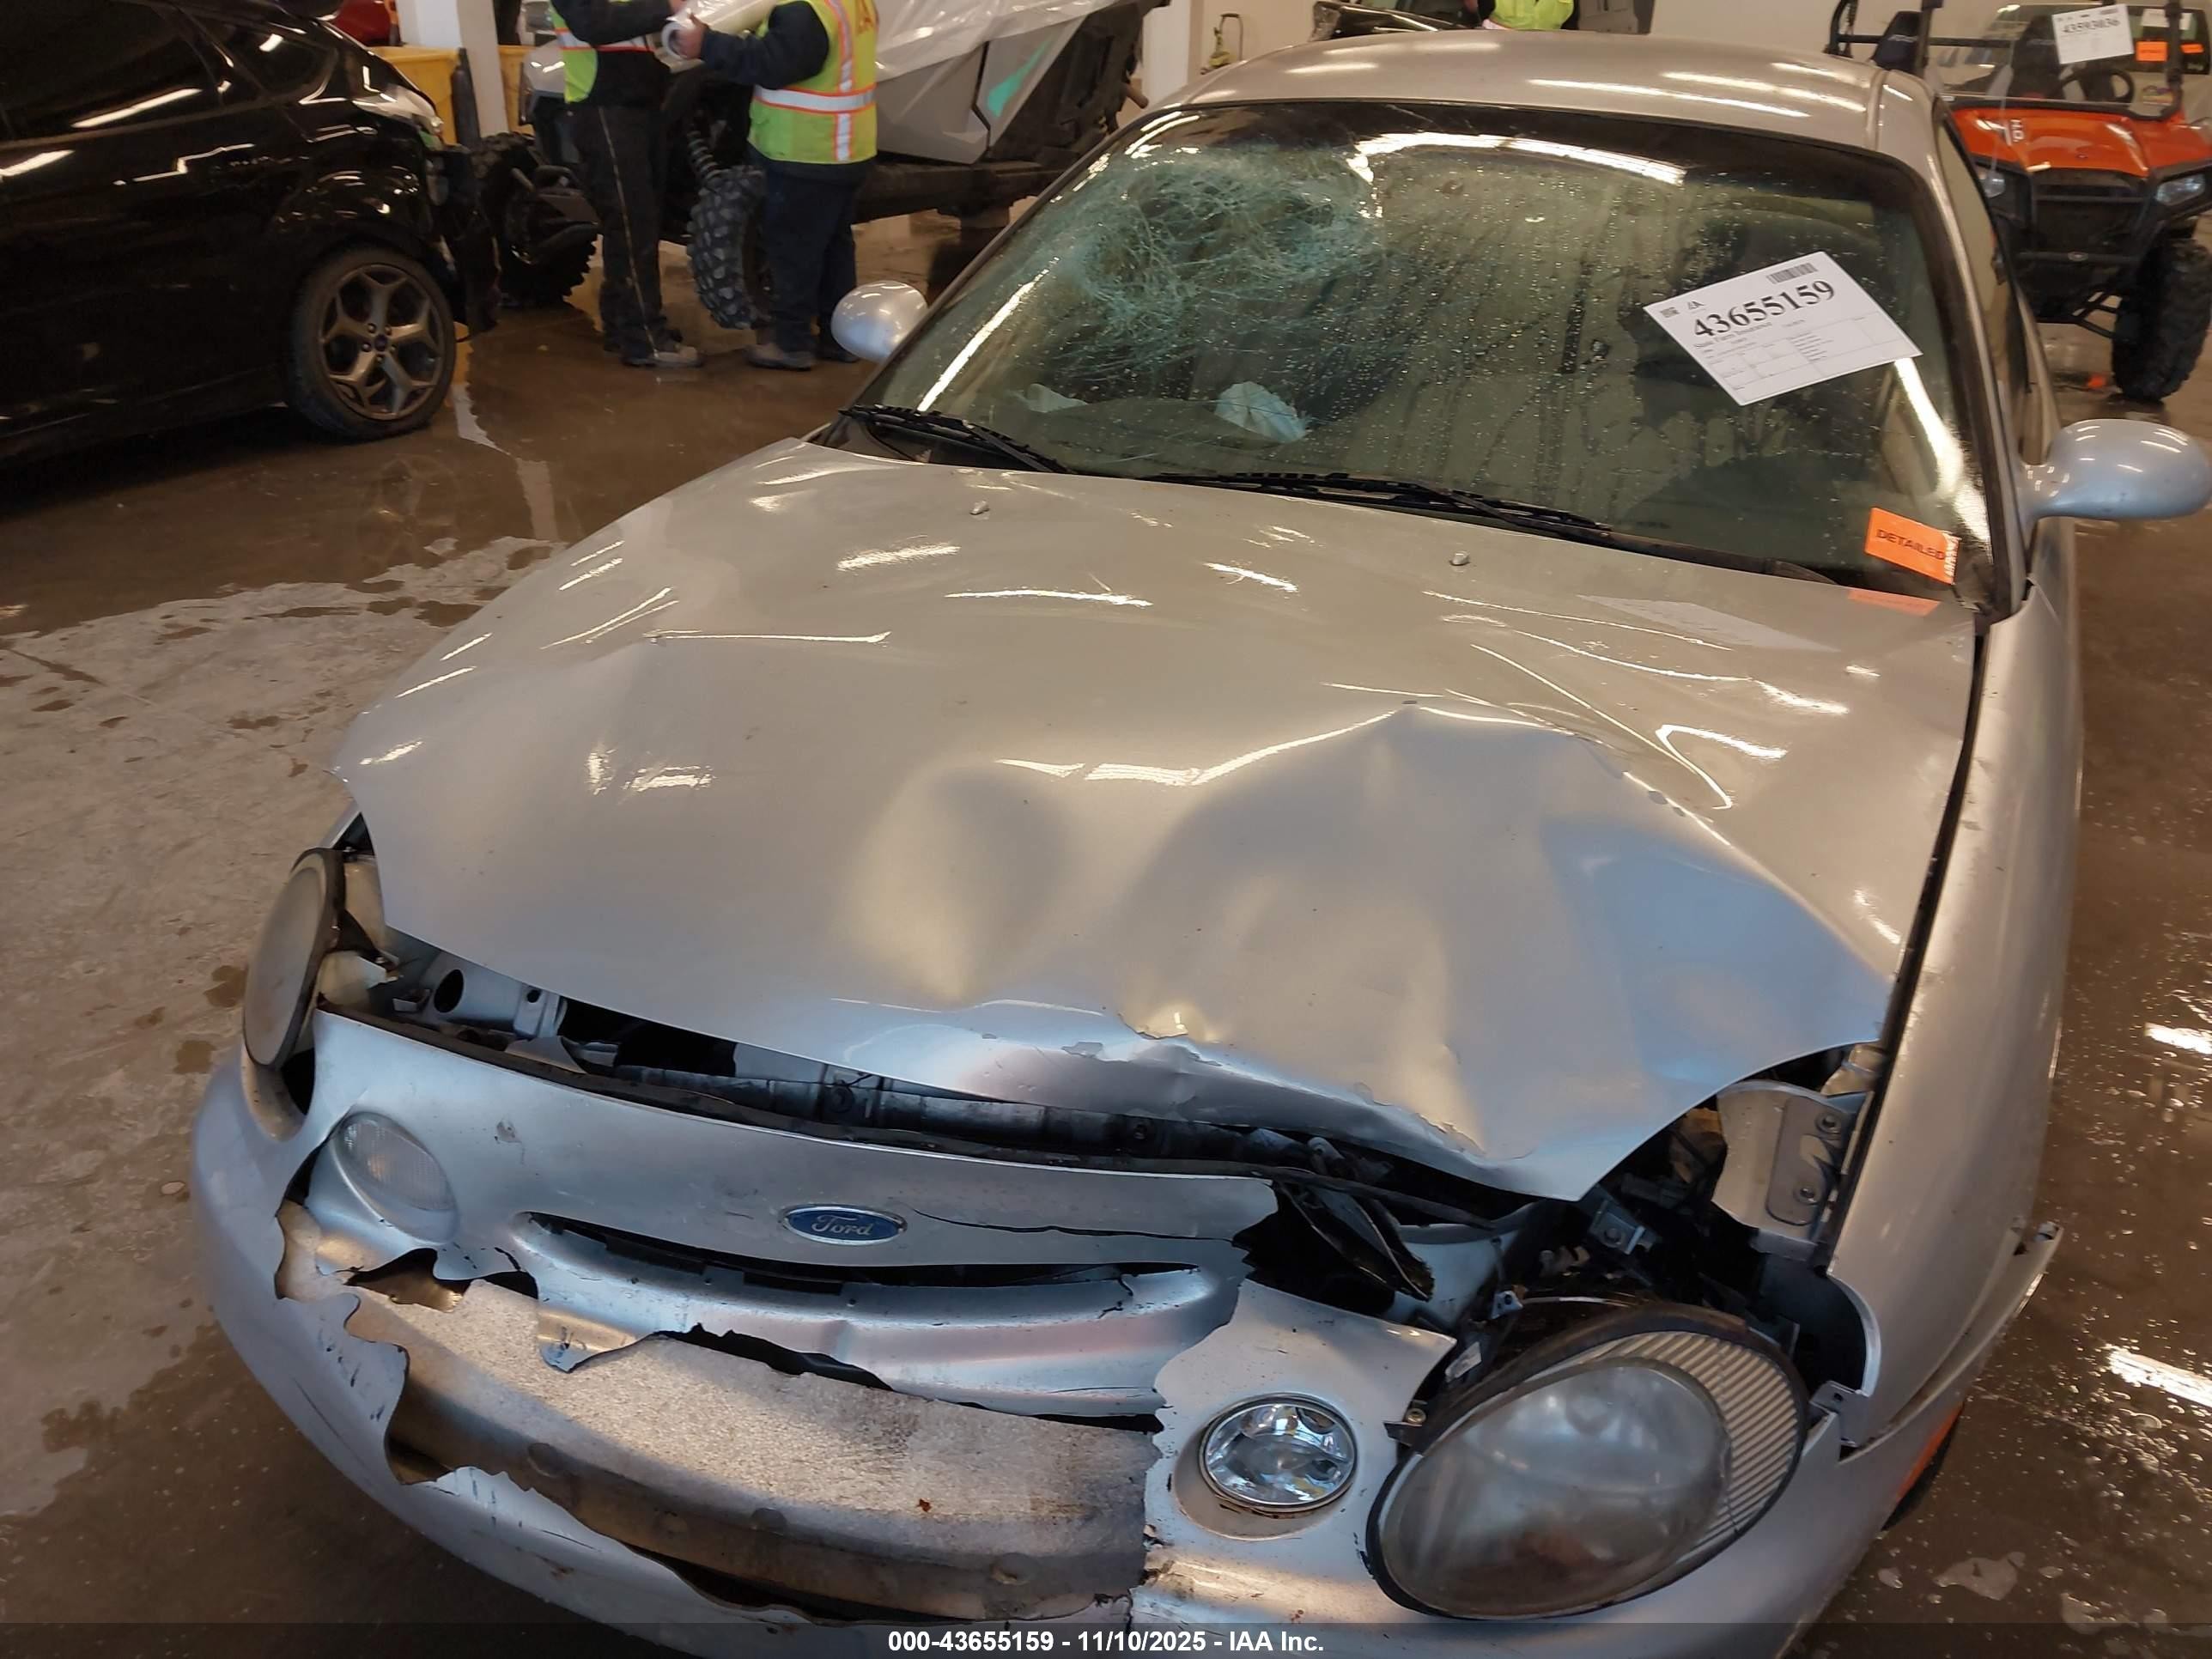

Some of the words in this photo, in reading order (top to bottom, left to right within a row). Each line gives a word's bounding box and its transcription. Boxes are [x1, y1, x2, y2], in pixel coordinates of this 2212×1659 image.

[1694, 280, 1835, 337] 43655159
[1875, 529, 1946, 561] DETAILED
[811, 1214, 874, 1236] Ford
